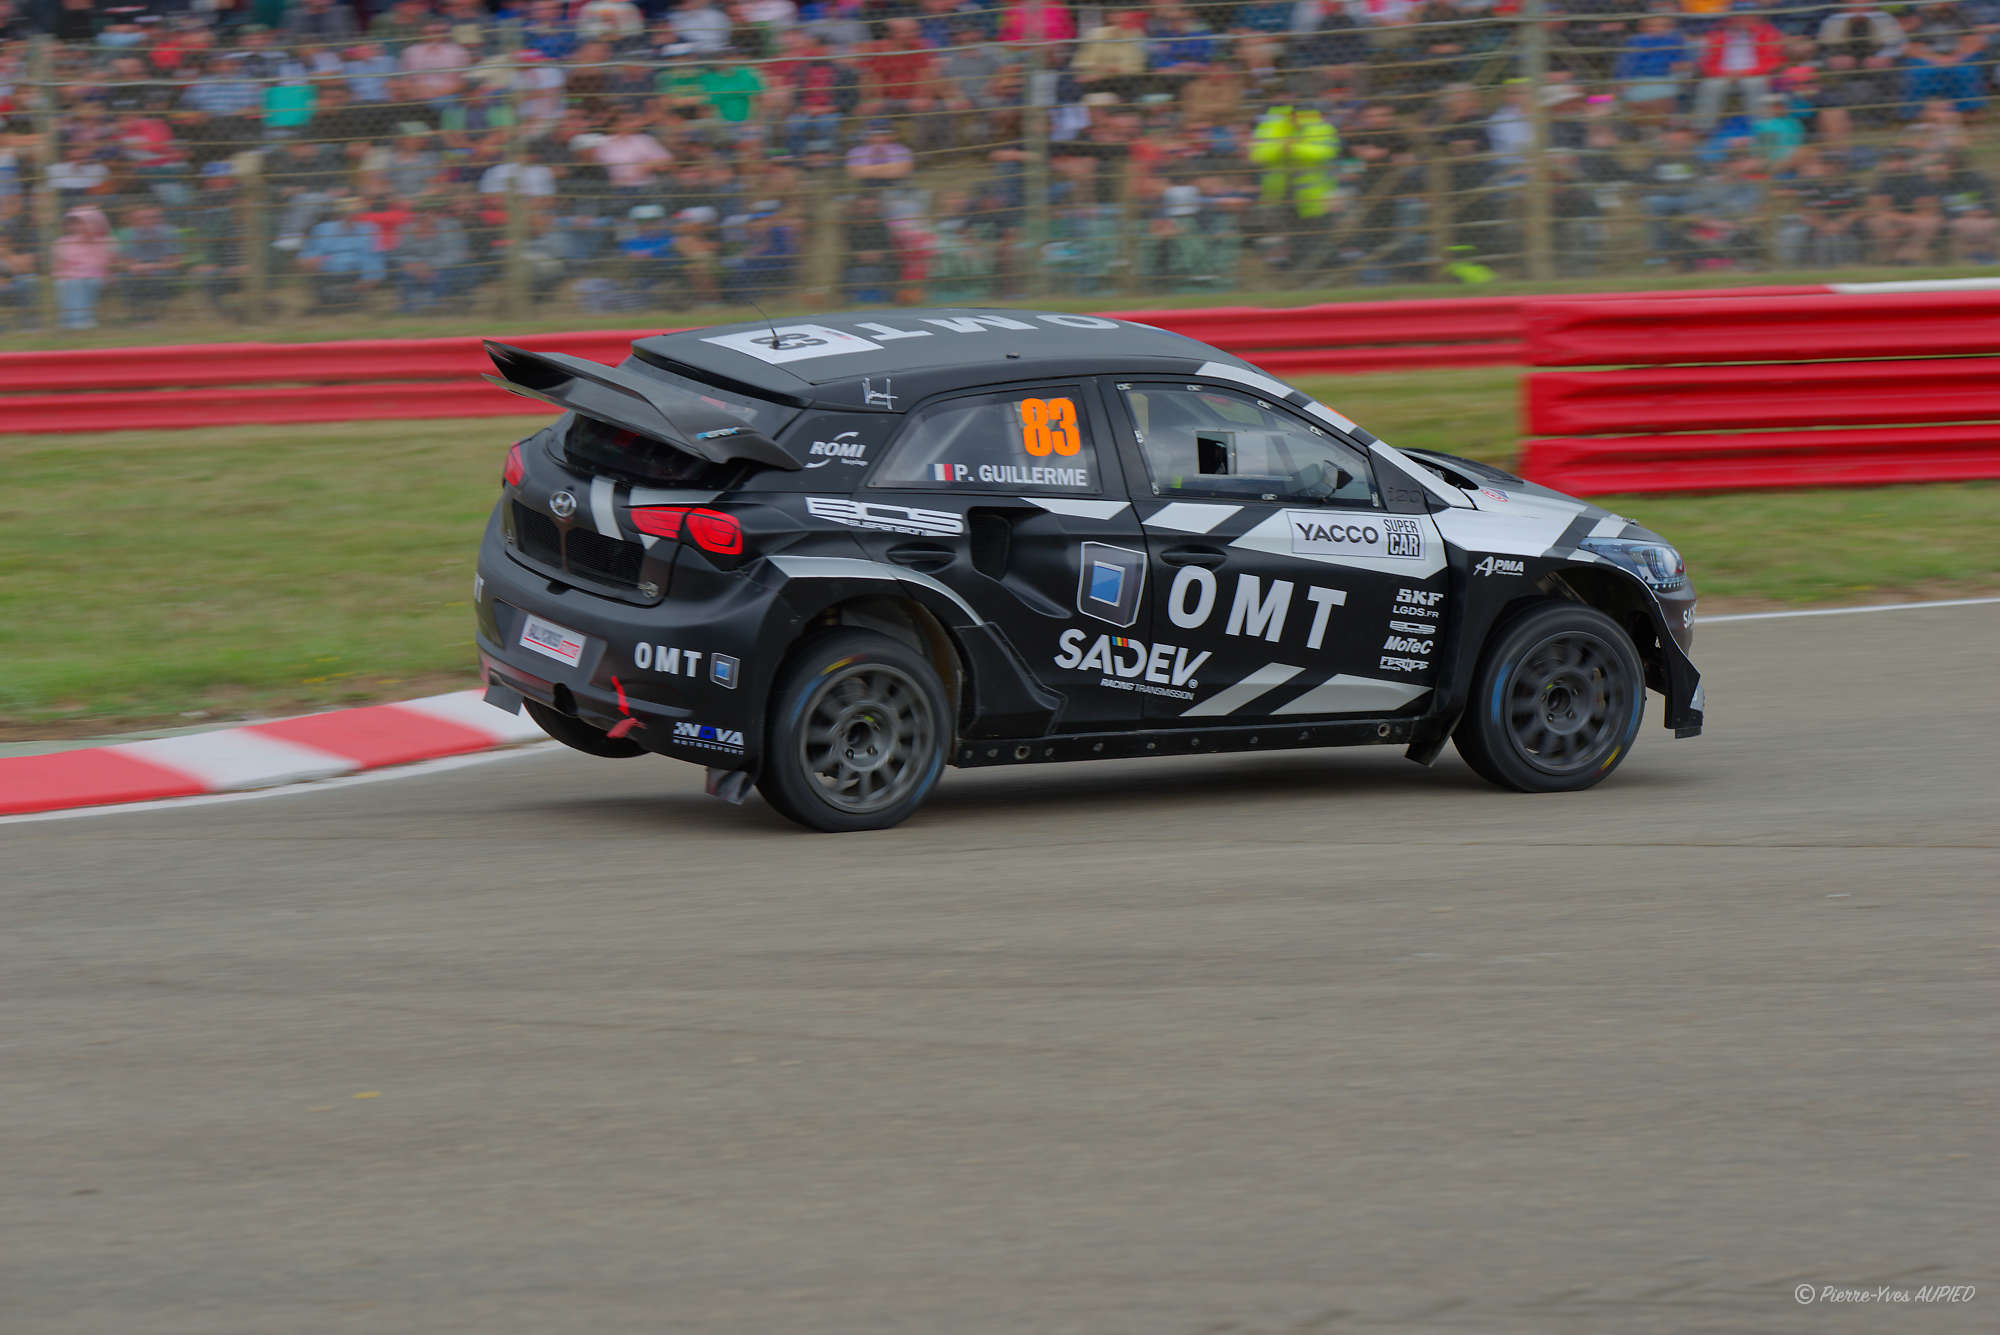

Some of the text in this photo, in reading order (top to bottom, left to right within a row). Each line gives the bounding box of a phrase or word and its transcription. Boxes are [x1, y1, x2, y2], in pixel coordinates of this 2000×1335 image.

[856, 314, 1120, 341] OMT
[1020, 398, 1081, 457] 83
[809, 441, 866, 458] ROMI
[954, 464, 1088, 486] P. GUILLERME
[1296, 522, 1379, 545] YACCO
[1384, 518, 1418, 533] SUPER
[1389, 533, 1419, 556] CAR
[1168, 565, 1347, 650] OMT
[1396, 588, 1444, 606] SKF
[1393, 605, 1440, 618] LGDS.FR
[1383, 635, 1434, 655] MoTeC
[634, 642, 702, 677] OMT
[1054, 628, 1213, 686] SADEV
